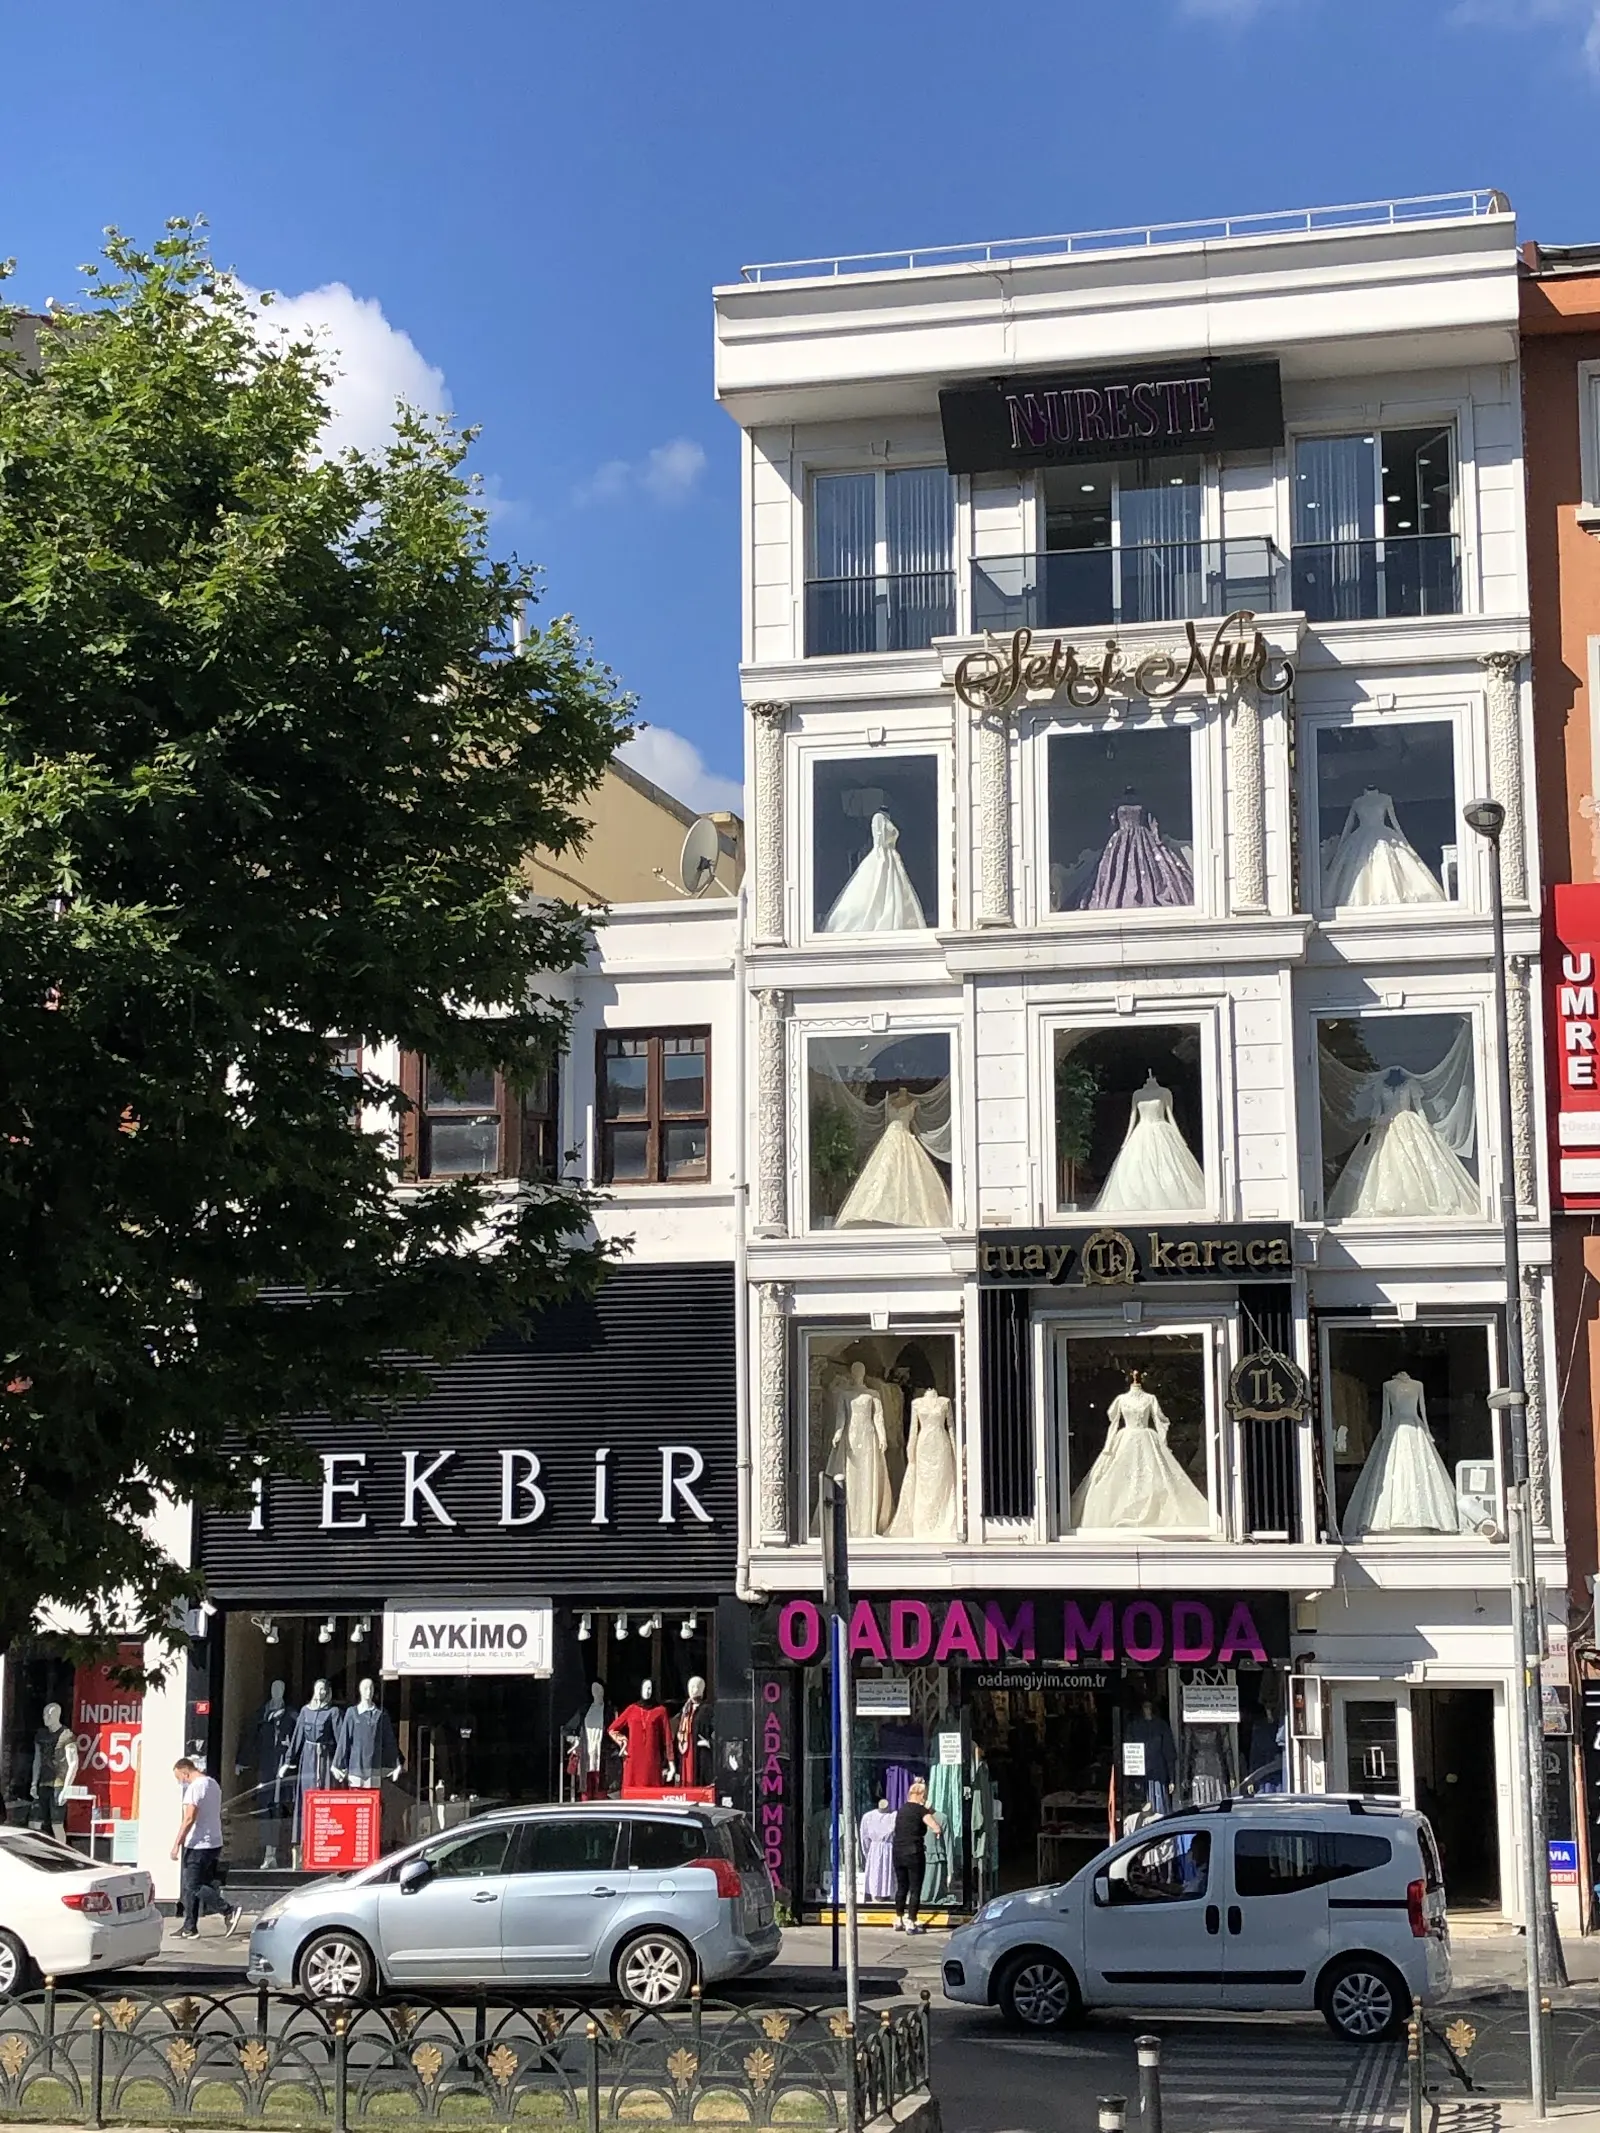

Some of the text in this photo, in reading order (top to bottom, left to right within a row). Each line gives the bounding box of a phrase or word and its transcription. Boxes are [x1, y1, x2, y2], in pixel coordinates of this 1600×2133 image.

[1005, 378, 1215, 449] NURESTE
[1561, 952, 1595, 1085] UMRE
[978, 1241, 1072, 1280] tuay
[1148, 1232, 1292, 1269] karaca
[409, 1617, 528, 1650] AYKİMO
[777, 1600, 1268, 1663] O ADAM MODA
[977, 1670, 1108, 1691] oadamgiyim.com.tr
[761, 1682, 784, 1890] O ADAM MODA
